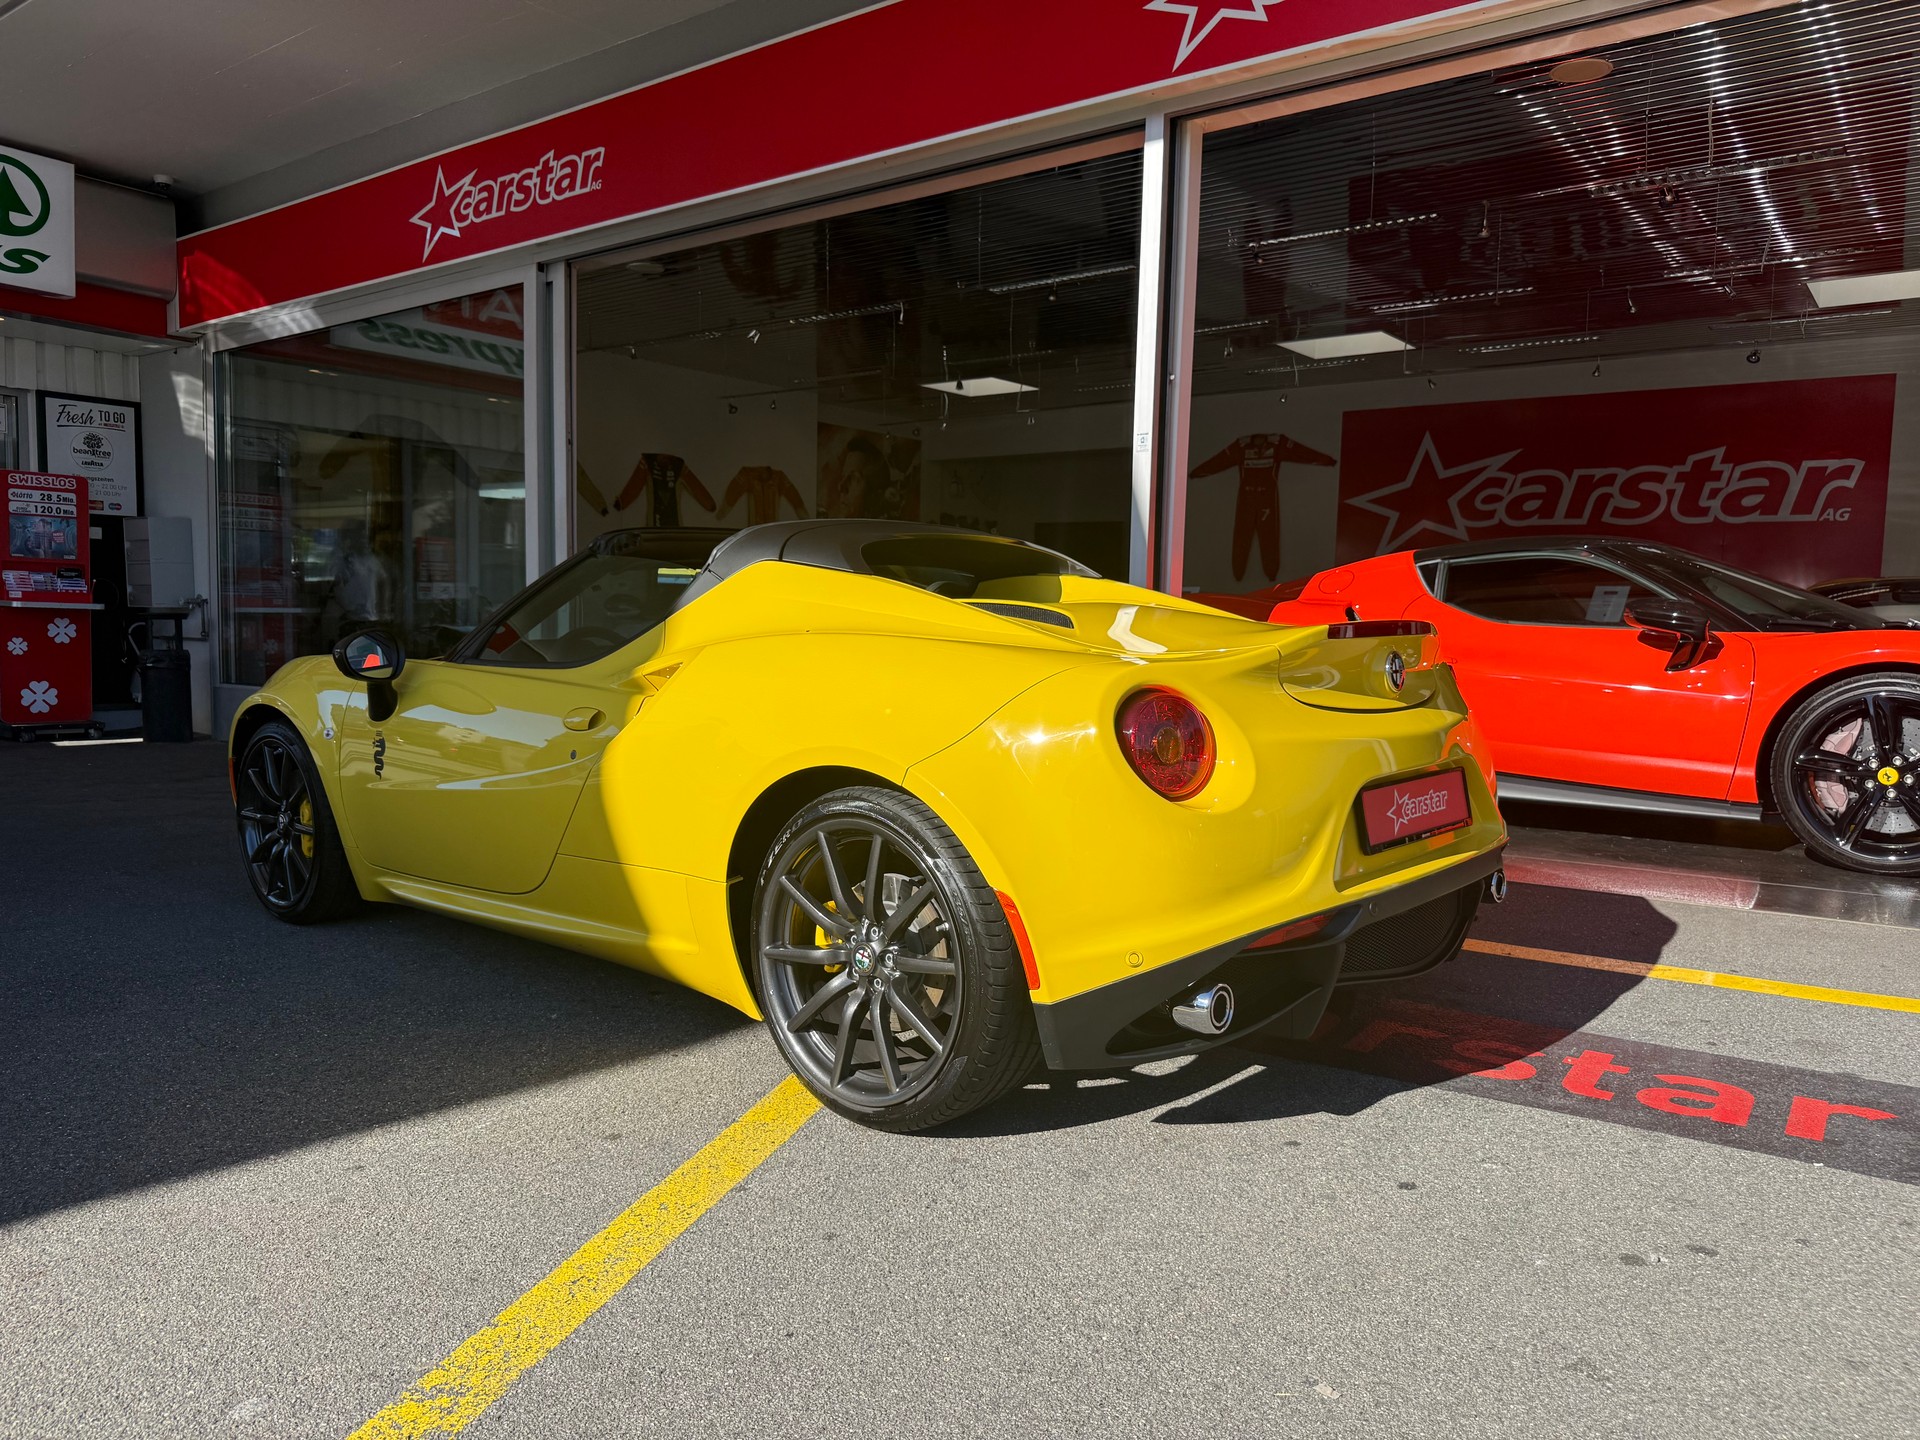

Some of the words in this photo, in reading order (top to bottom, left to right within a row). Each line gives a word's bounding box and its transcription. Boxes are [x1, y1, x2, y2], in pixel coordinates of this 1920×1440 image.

[450, 147, 606, 228] carstar
[590, 179, 602, 191] AG
[56, 404, 96, 426] Fresh
[98, 410, 110, 423] TO
[113, 411, 126, 424] GO
[9, 474, 76, 488] SWISSLOS
[1462, 446, 1866, 528] carstar
[1820, 507, 1851, 522] AG
[40, 492, 62, 503] 28.5
[34, 505, 62, 515] 120.0
[1402, 788, 1448, 820] carstar
